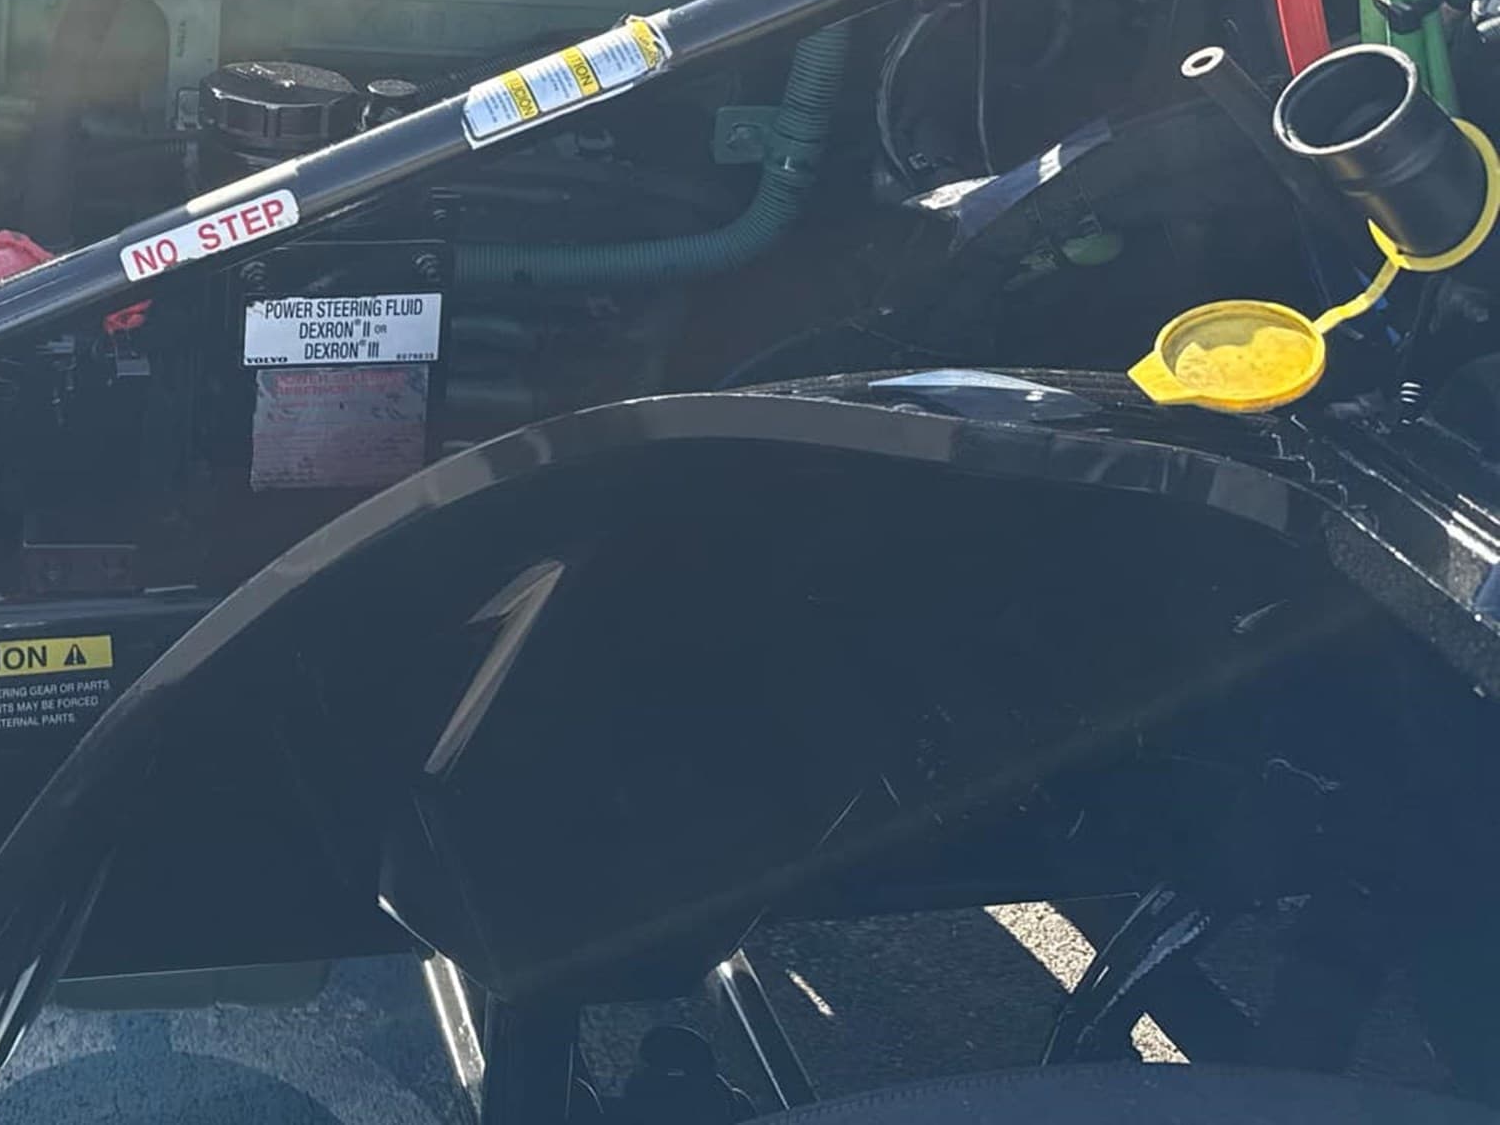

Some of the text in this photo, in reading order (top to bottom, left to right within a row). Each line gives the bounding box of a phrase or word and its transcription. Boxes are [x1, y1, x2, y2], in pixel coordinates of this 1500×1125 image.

[131, 199, 284, 276] NO STEP
[265, 297, 423, 320] POWER STEERING FLUID
[362, 321, 371, 338] II
[374, 325, 387, 335] OR
[367, 341, 380, 359] III
[245, 355, 288, 364] VOLVO
[29, 683, 57, 696] GEAR
[59, 682, 75, 693] OR
[77, 678, 111, 692] PARTS
[16, 700, 39, 713] MAY
[41, 698, 55, 711] BE
[57, 695, 99, 709] FORCED
[41, 712, 76, 726] PARTS
